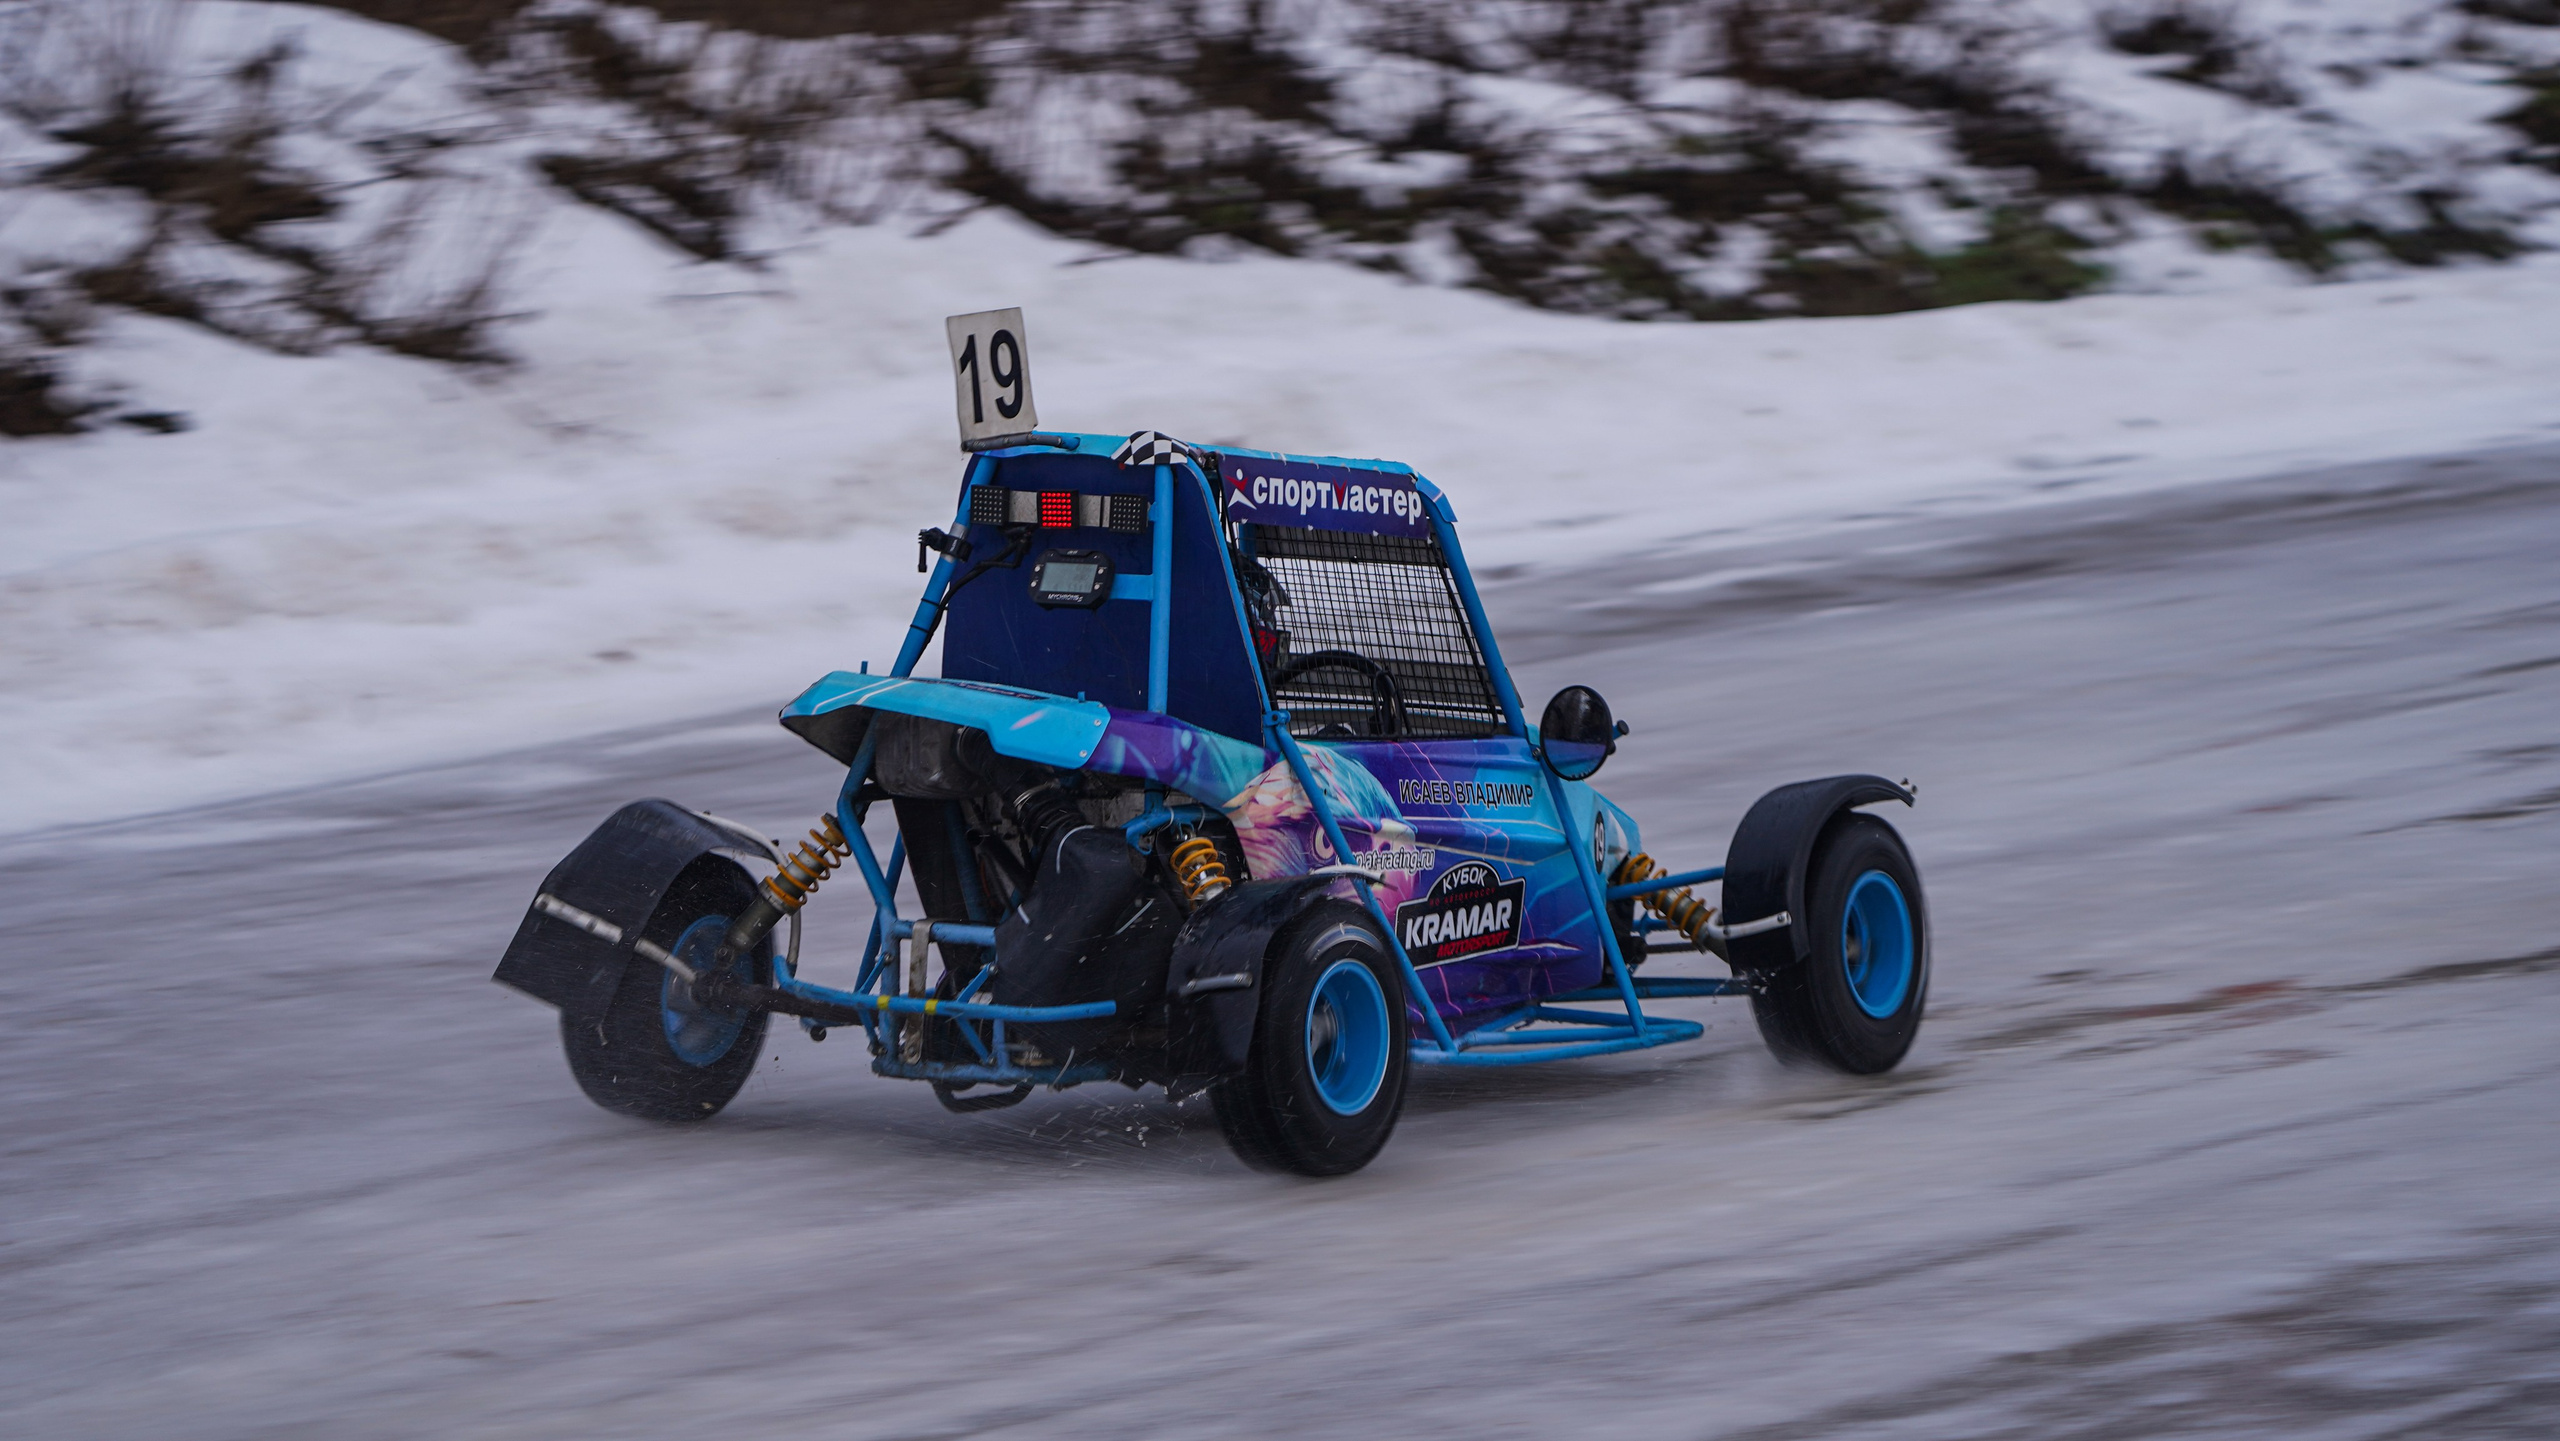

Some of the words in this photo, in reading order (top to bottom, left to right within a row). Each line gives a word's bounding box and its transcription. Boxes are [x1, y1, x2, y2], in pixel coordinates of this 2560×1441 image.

[959, 329, 1023, 424] 19
[1399, 779, 1452, 804] ИСАЕВ
[1454, 781, 1533, 810] ВЛАДИМИР
[1595, 822, 1604, 862] 19
[1443, 866, 1488, 895] КУБОК
[1405, 898, 1513, 950] KRAMAR
[1437, 930, 1510, 958] MOTORSPORT
